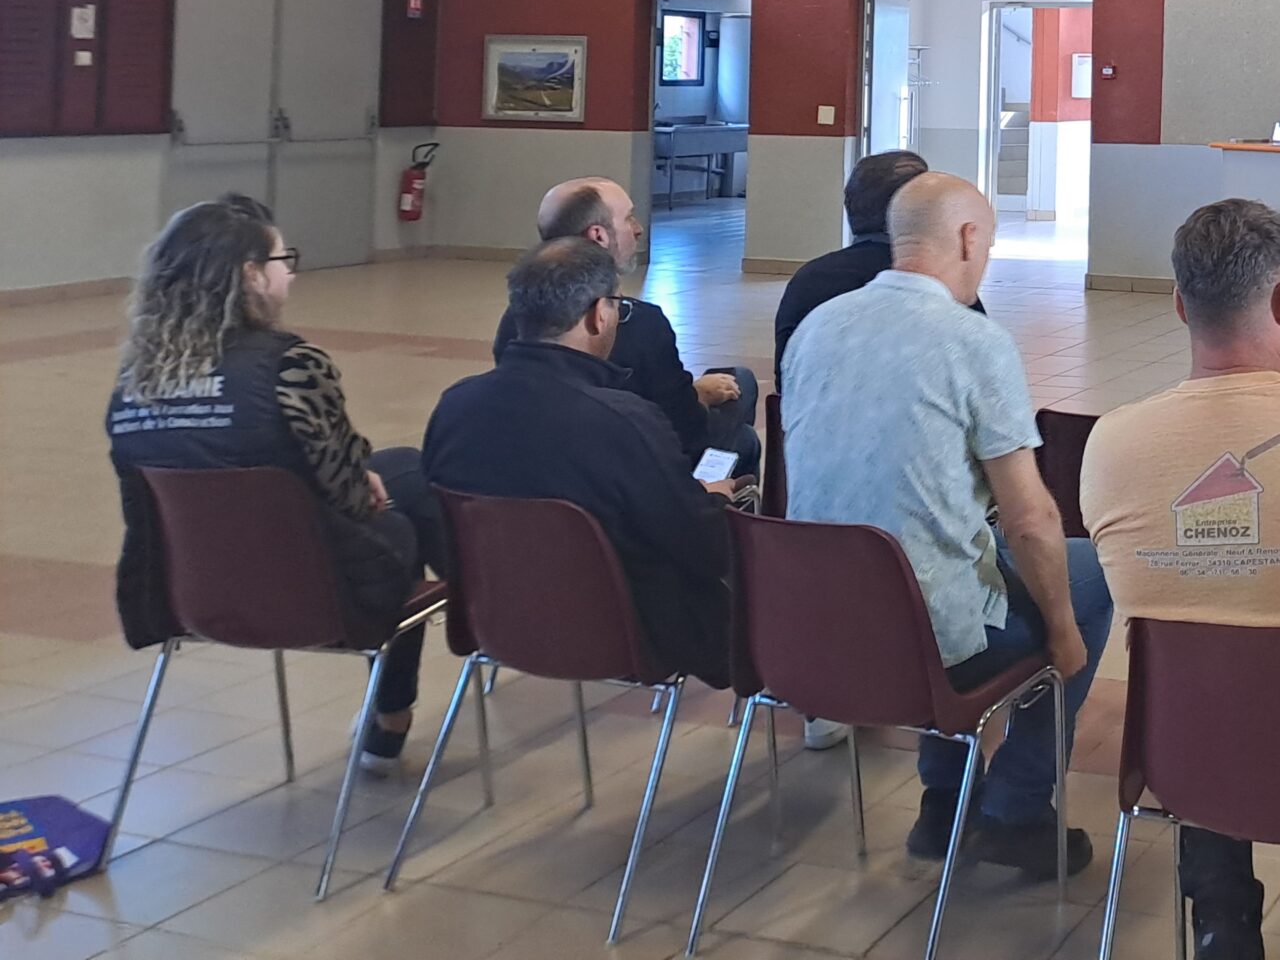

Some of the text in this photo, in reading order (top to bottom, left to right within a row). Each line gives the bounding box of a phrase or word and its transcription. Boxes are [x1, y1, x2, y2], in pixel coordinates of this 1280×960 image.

[1195, 519, 1238, 527] Entreprise
[1183, 526, 1251, 540] CHENOZ
[1135, 549, 1179, 559] Maçonnerie
[1226, 548, 1245, 557] Neuf
[1248, 548, 1254, 556] &
